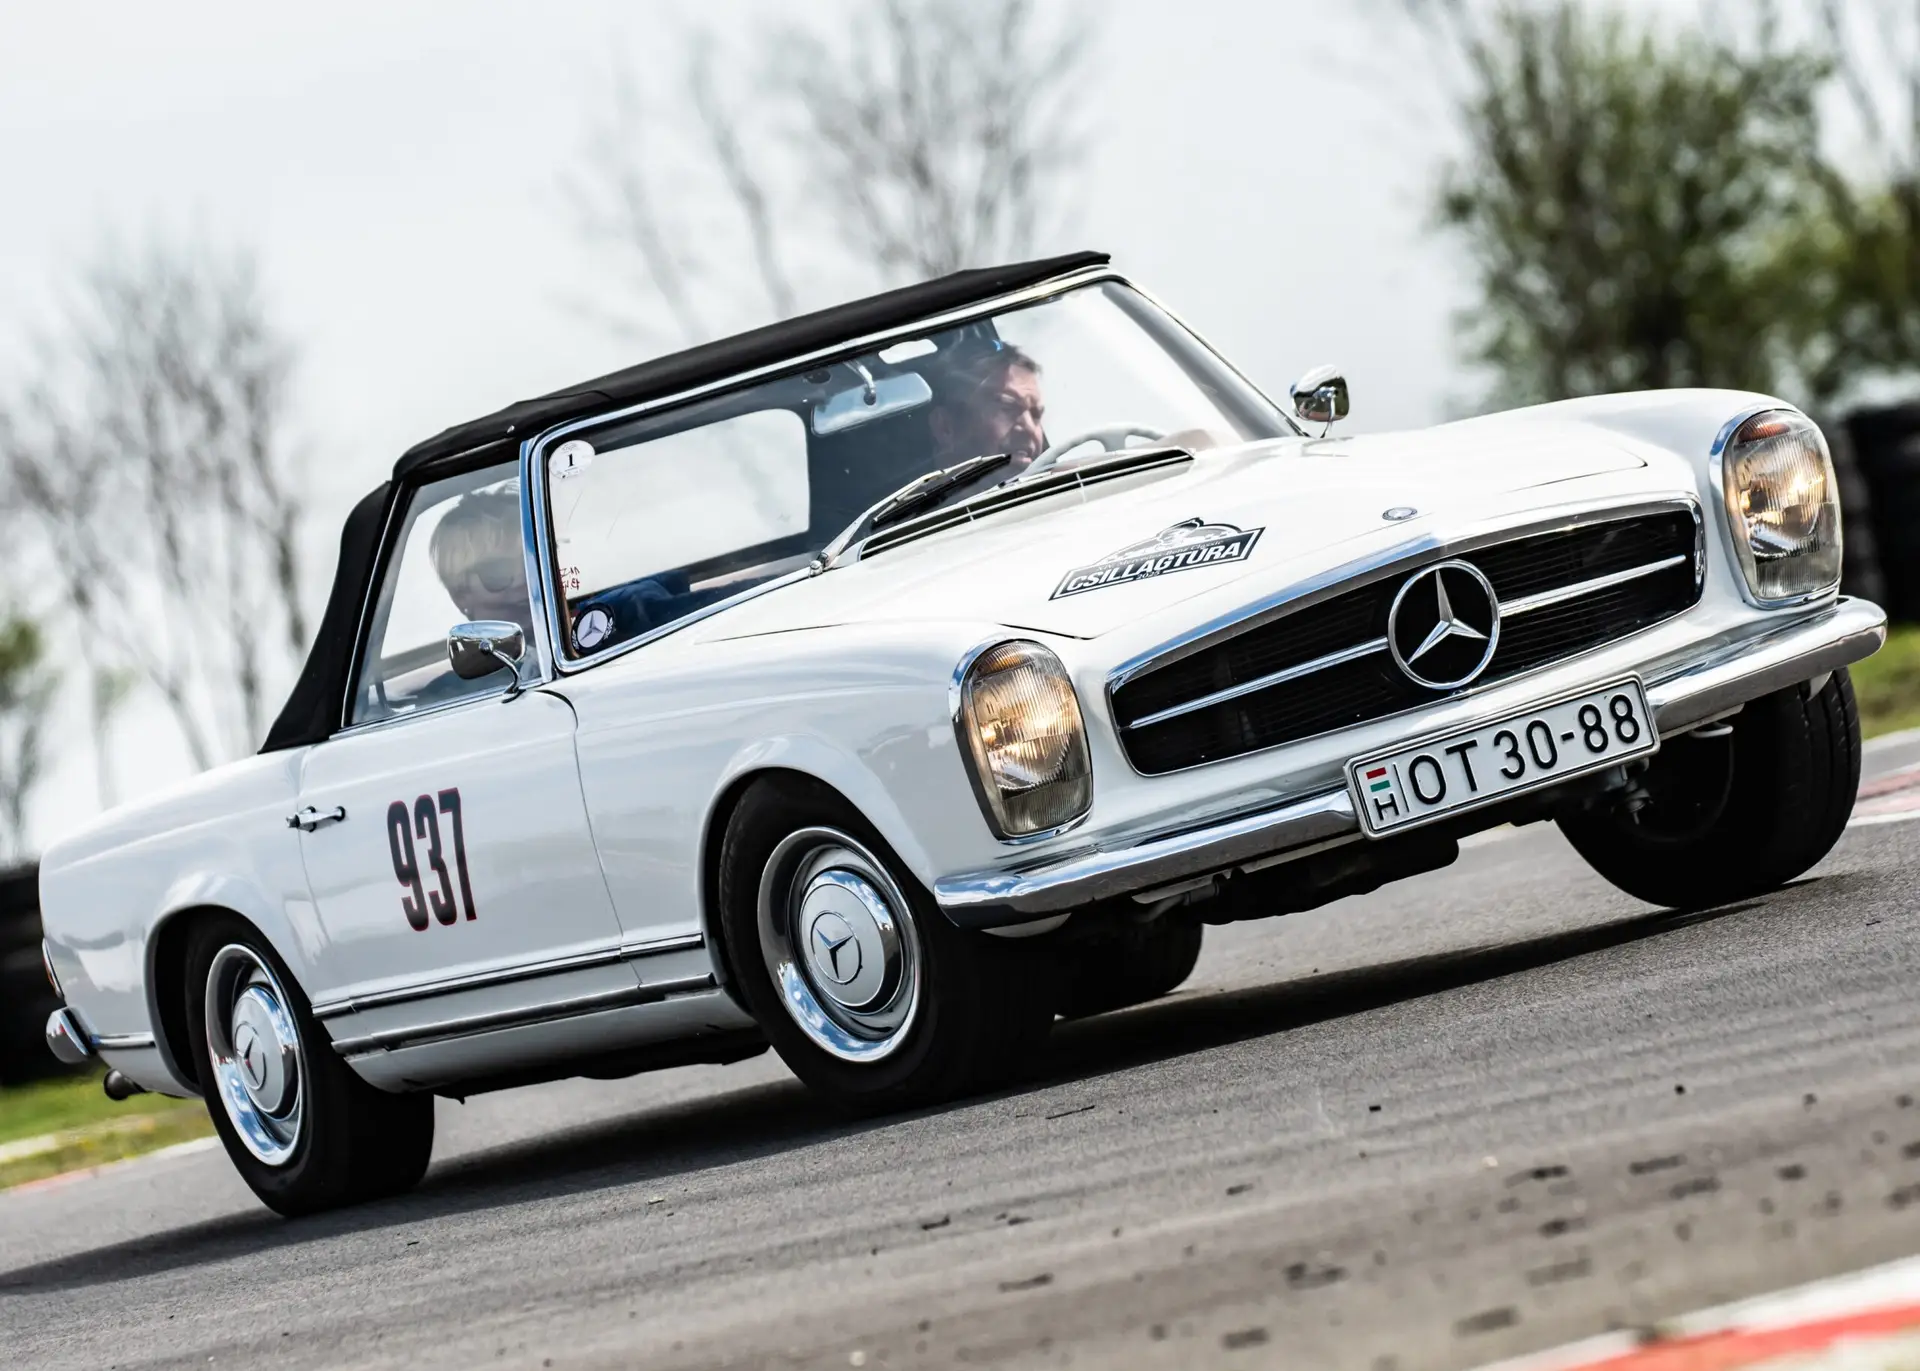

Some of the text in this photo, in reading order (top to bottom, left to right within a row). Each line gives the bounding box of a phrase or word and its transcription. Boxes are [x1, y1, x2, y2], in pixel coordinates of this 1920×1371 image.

[568, 453, 574, 467] 1
[1066, 541, 1241, 592] CSILLAGTURA
[1408, 694, 1640, 804] OT 30-88
[1373, 792, 1400, 821] H
[387, 787, 477, 932] 937
